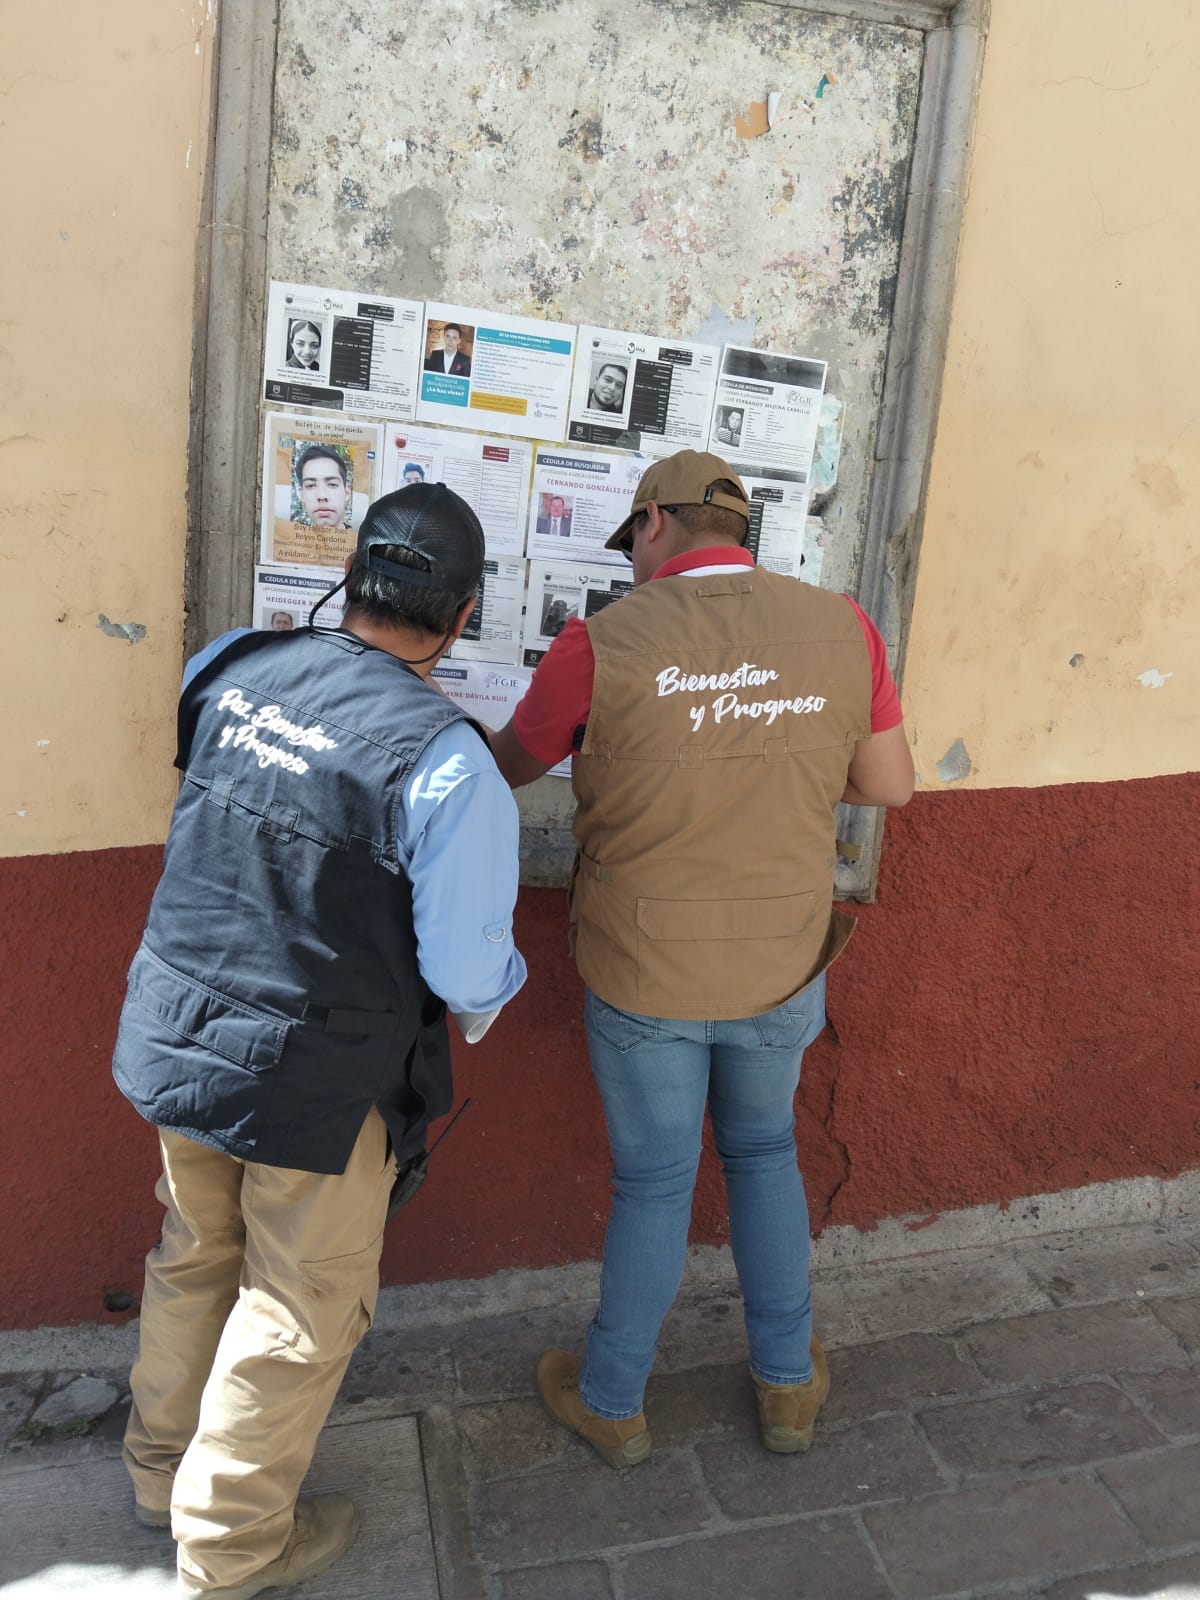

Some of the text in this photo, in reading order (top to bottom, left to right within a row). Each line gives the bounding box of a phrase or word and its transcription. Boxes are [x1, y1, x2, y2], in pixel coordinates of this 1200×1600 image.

[736, 398, 764, 408] FERNANDO
[764, 402, 786, 411] MEDINA
[542, 456, 565, 466] CÉDULA
[574, 461, 606, 470] BÚSQUEDA
[546, 478, 584, 489] FERNANDO
[586, 484, 621, 494] GONZÁLEZ
[294, 522, 309, 533] Soy
[295, 532, 316, 542] Reyes
[316, 534, 346, 544] Cardona
[264, 575, 289, 584] CÉDULA
[298, 578, 330, 588] BÚSQUEDA
[266, 596, 307, 606] HEIDEGGER
[495, 678, 519, 688] FGJE
[656, 662, 780, 697] Bienestar
[466, 692, 490, 700] DÁVILA
[689, 693, 828, 732] y Progreso
[251, 705, 338, 752] Bienestar
[218, 724, 310, 775] y Progreso
